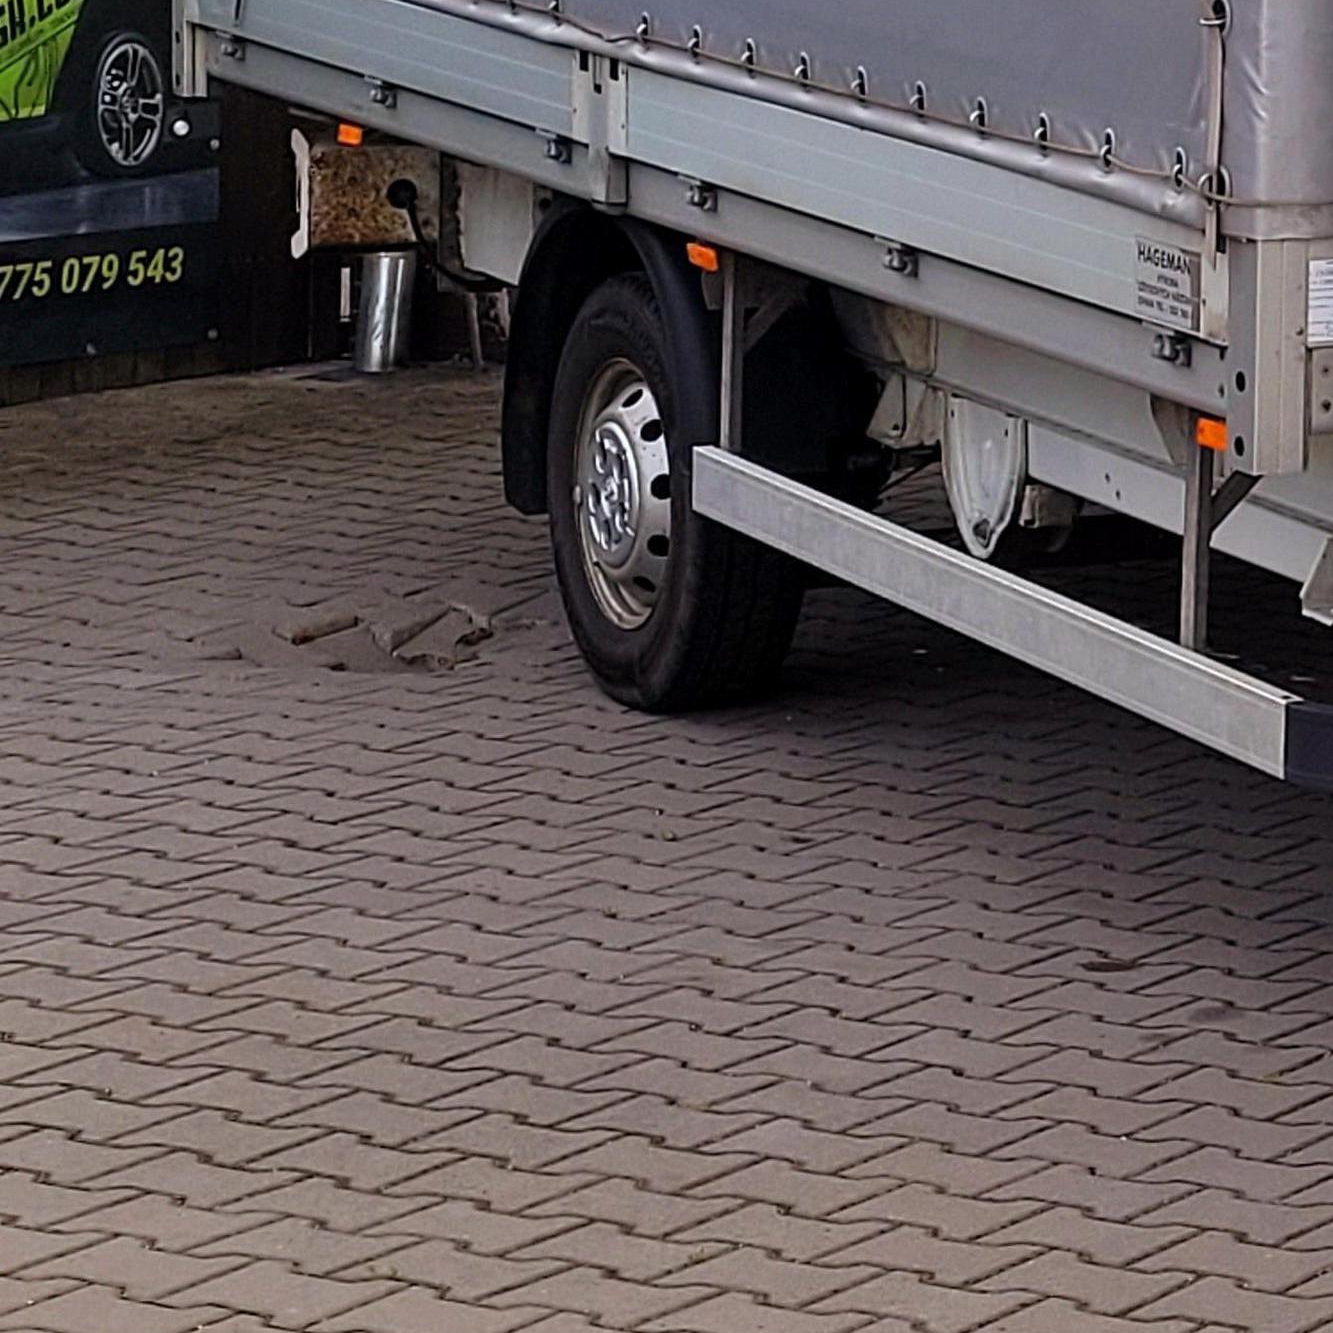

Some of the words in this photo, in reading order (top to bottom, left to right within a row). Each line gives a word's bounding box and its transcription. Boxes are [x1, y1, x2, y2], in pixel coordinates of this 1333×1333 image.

[0, 260, 52, 299] 775
[62, 253, 119, 294] 079
[127, 246, 184, 287] 543
